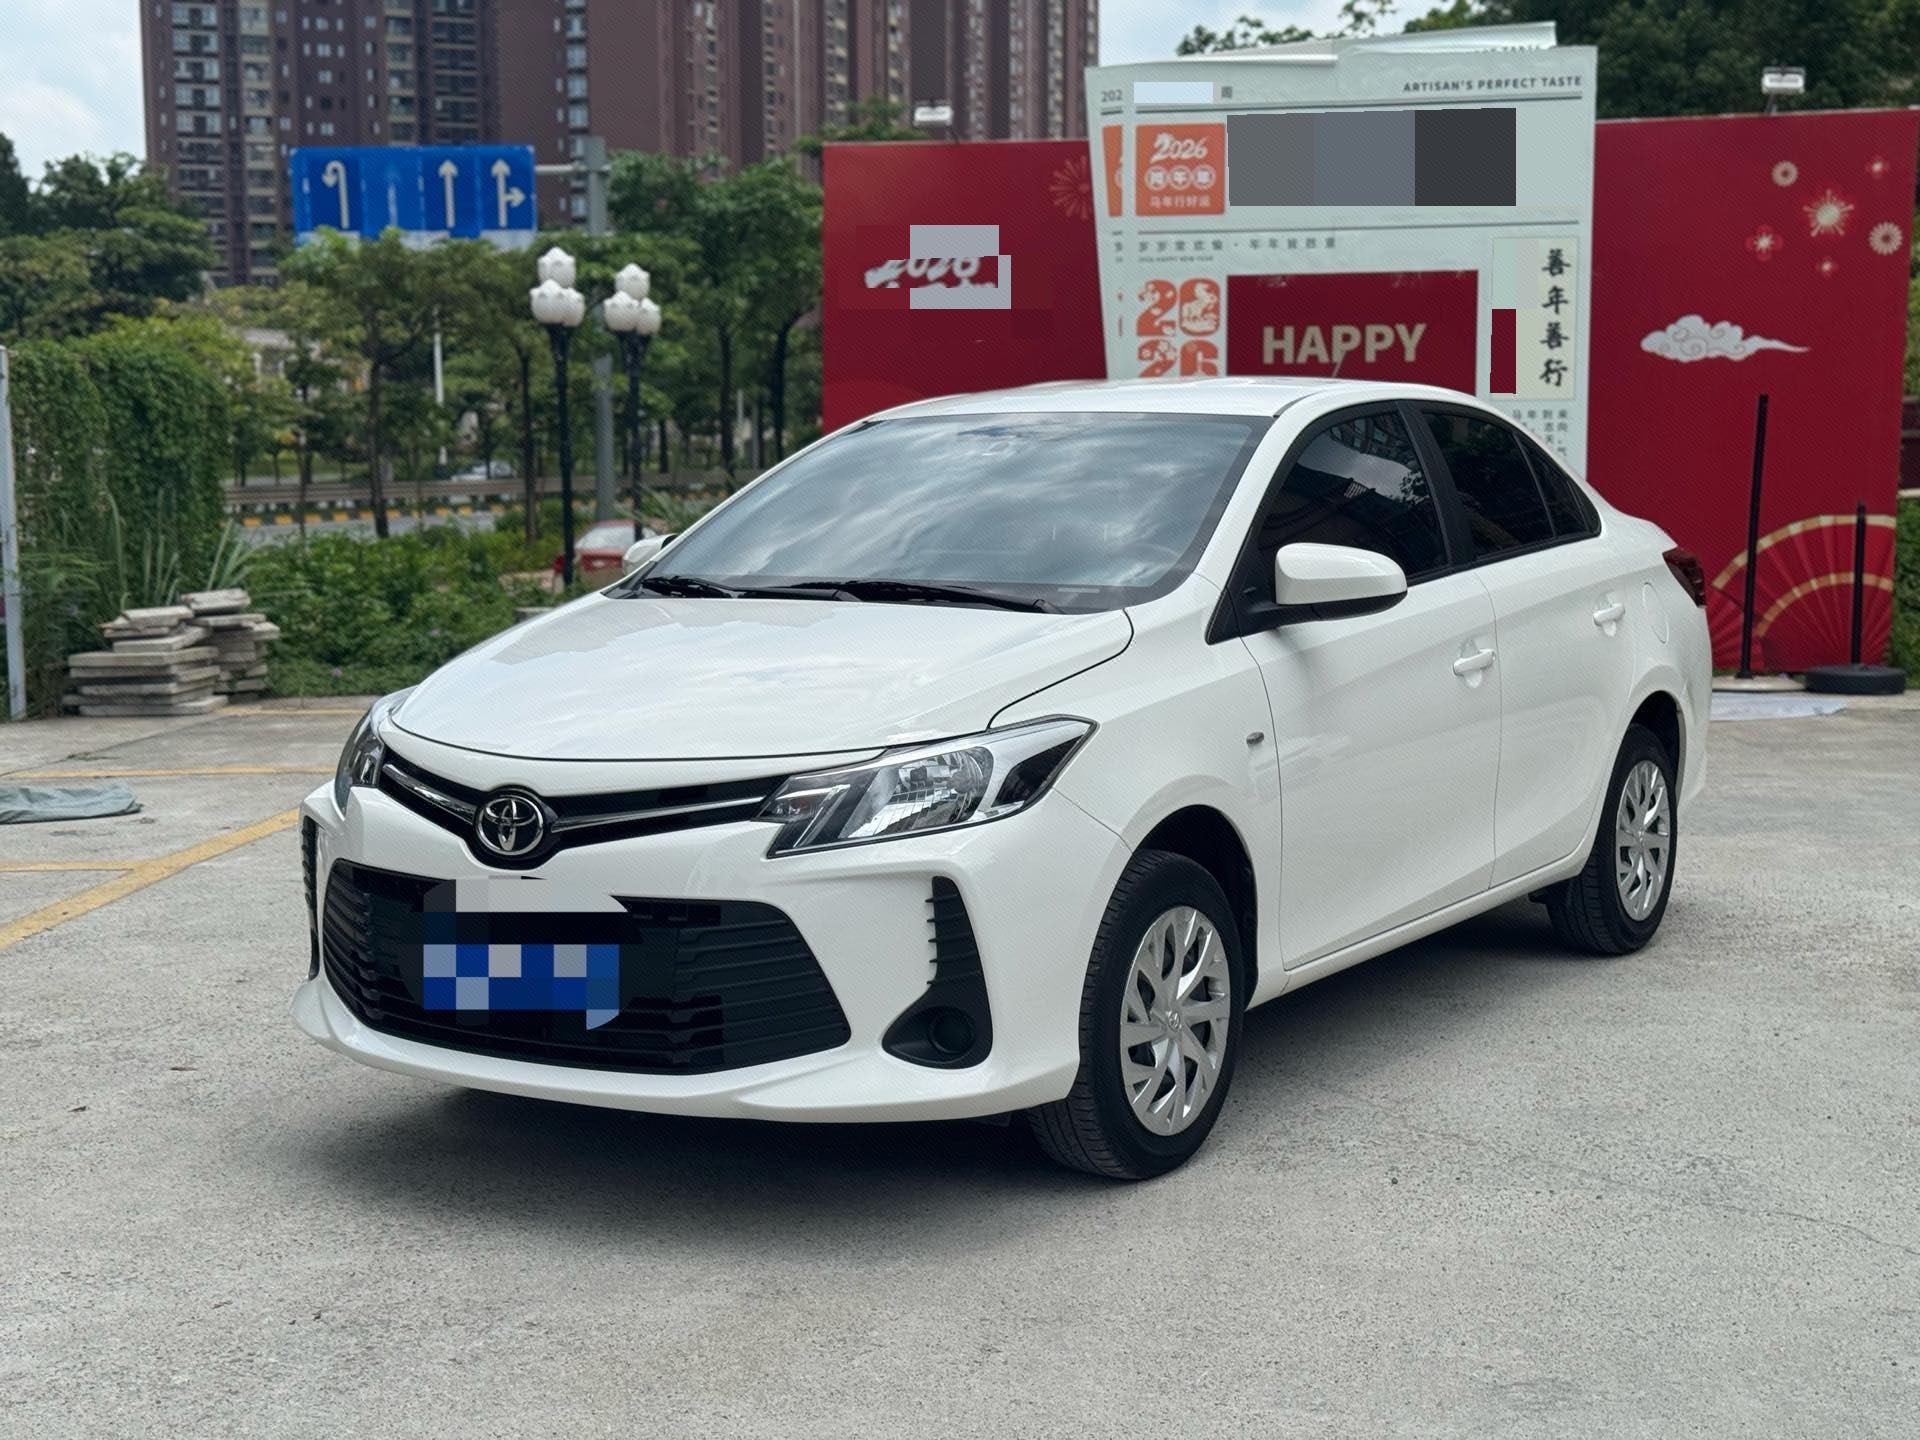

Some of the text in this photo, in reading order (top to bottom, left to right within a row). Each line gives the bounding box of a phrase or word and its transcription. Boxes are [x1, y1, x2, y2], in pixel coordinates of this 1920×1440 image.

[1403, 75, 1582, 92] ARTISAN'S PERFECT TASTE
[1149, 132, 1208, 164] 2026
[1540, 248, 1571, 387] 善年善行
[1262, 323, 1427, 365] HAPPY
